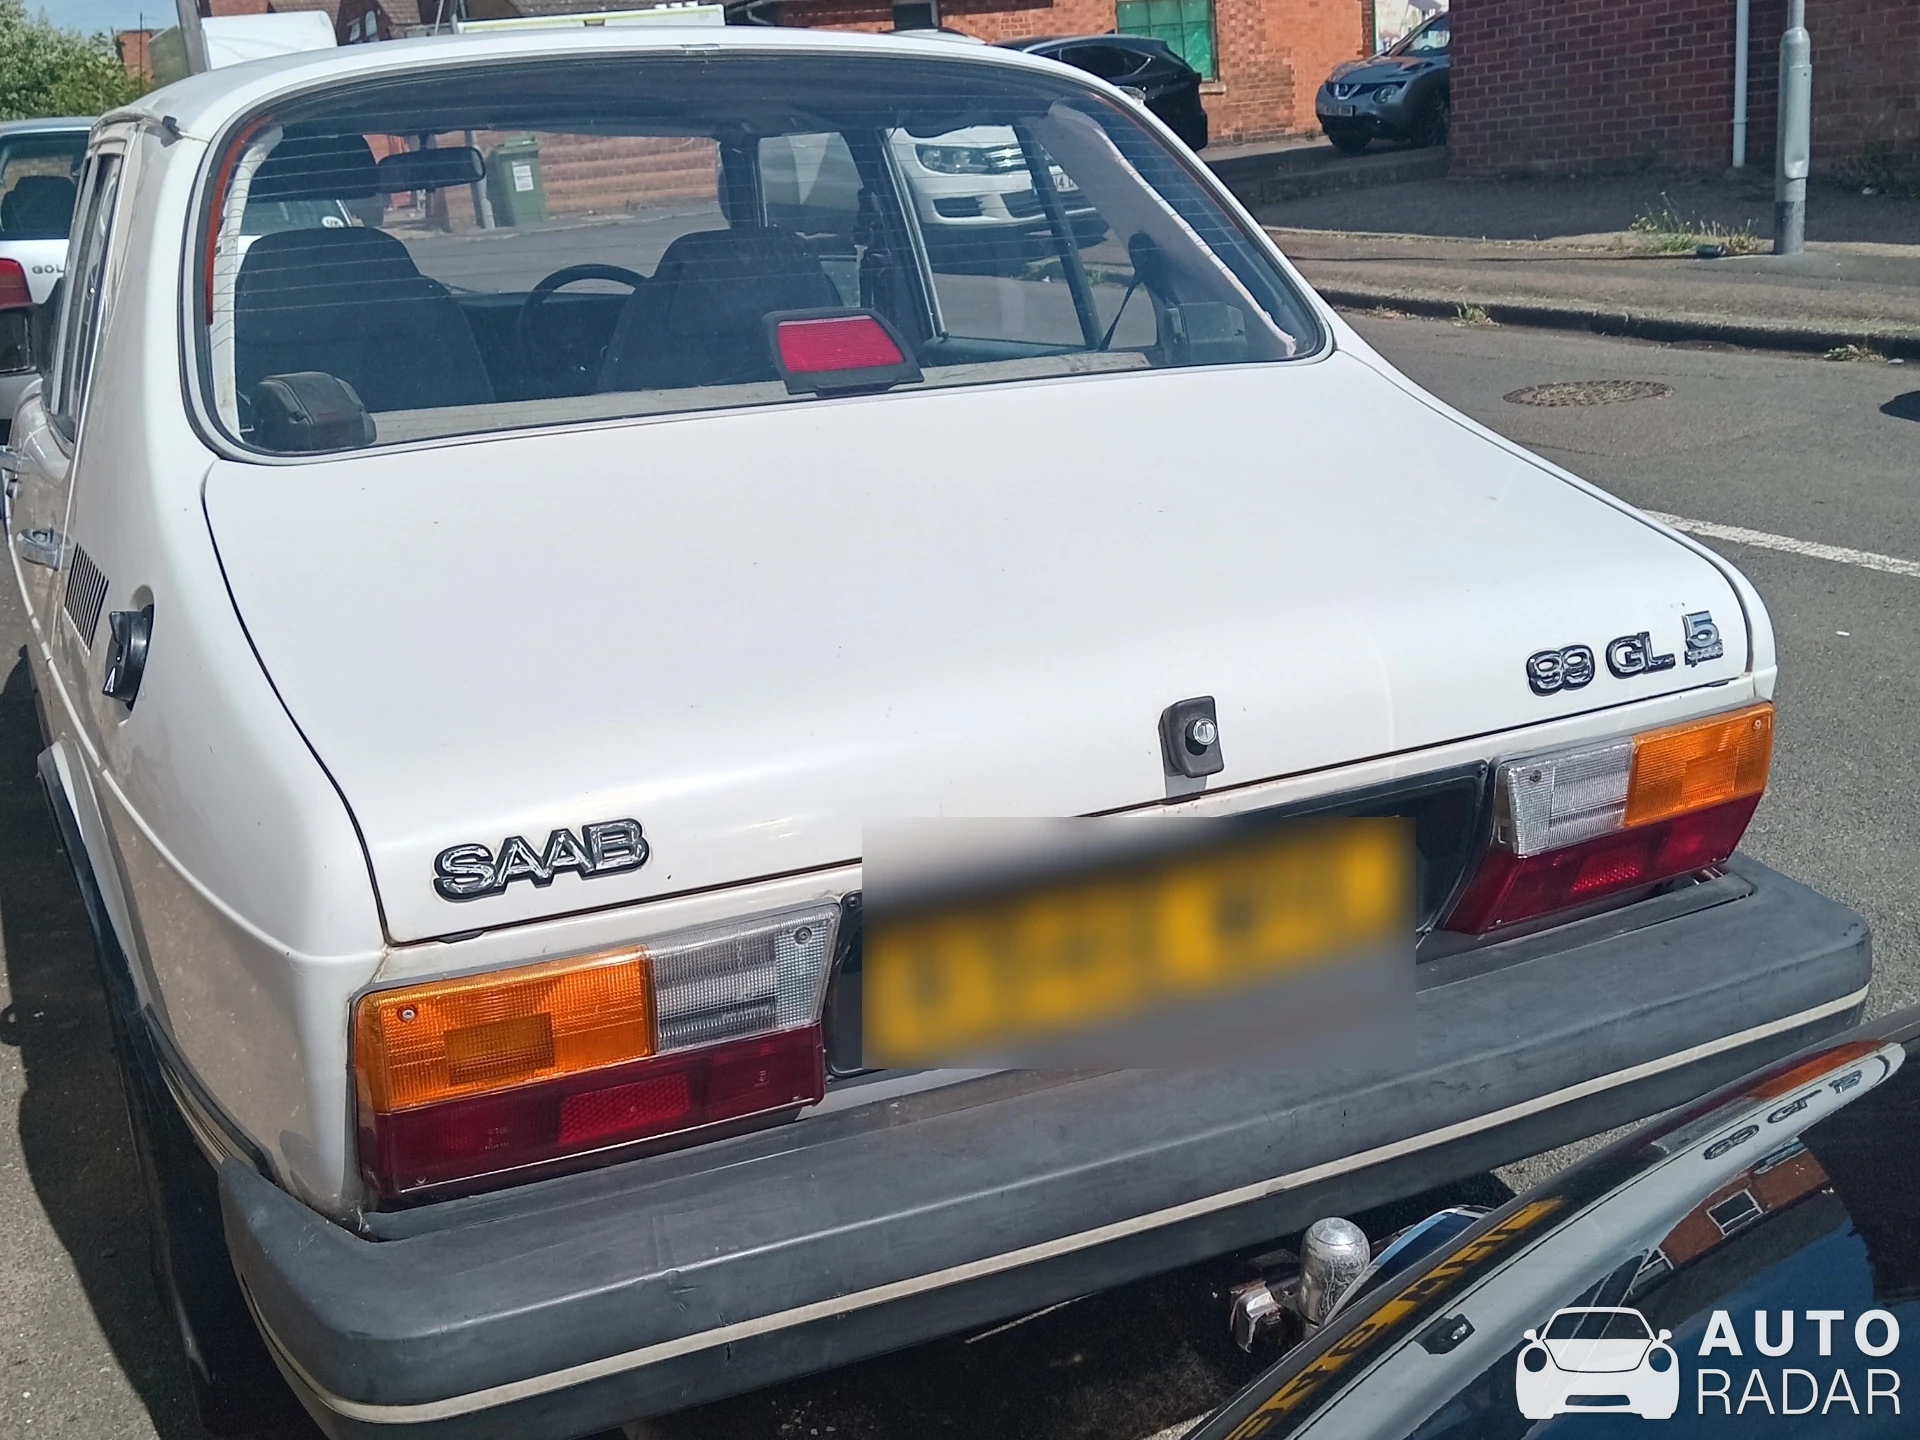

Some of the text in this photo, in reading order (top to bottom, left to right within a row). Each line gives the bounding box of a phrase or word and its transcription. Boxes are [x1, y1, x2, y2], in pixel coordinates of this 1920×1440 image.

[1526, 610, 1720, 697] 99 GL 5
[433, 817, 650, 903] SAAB
